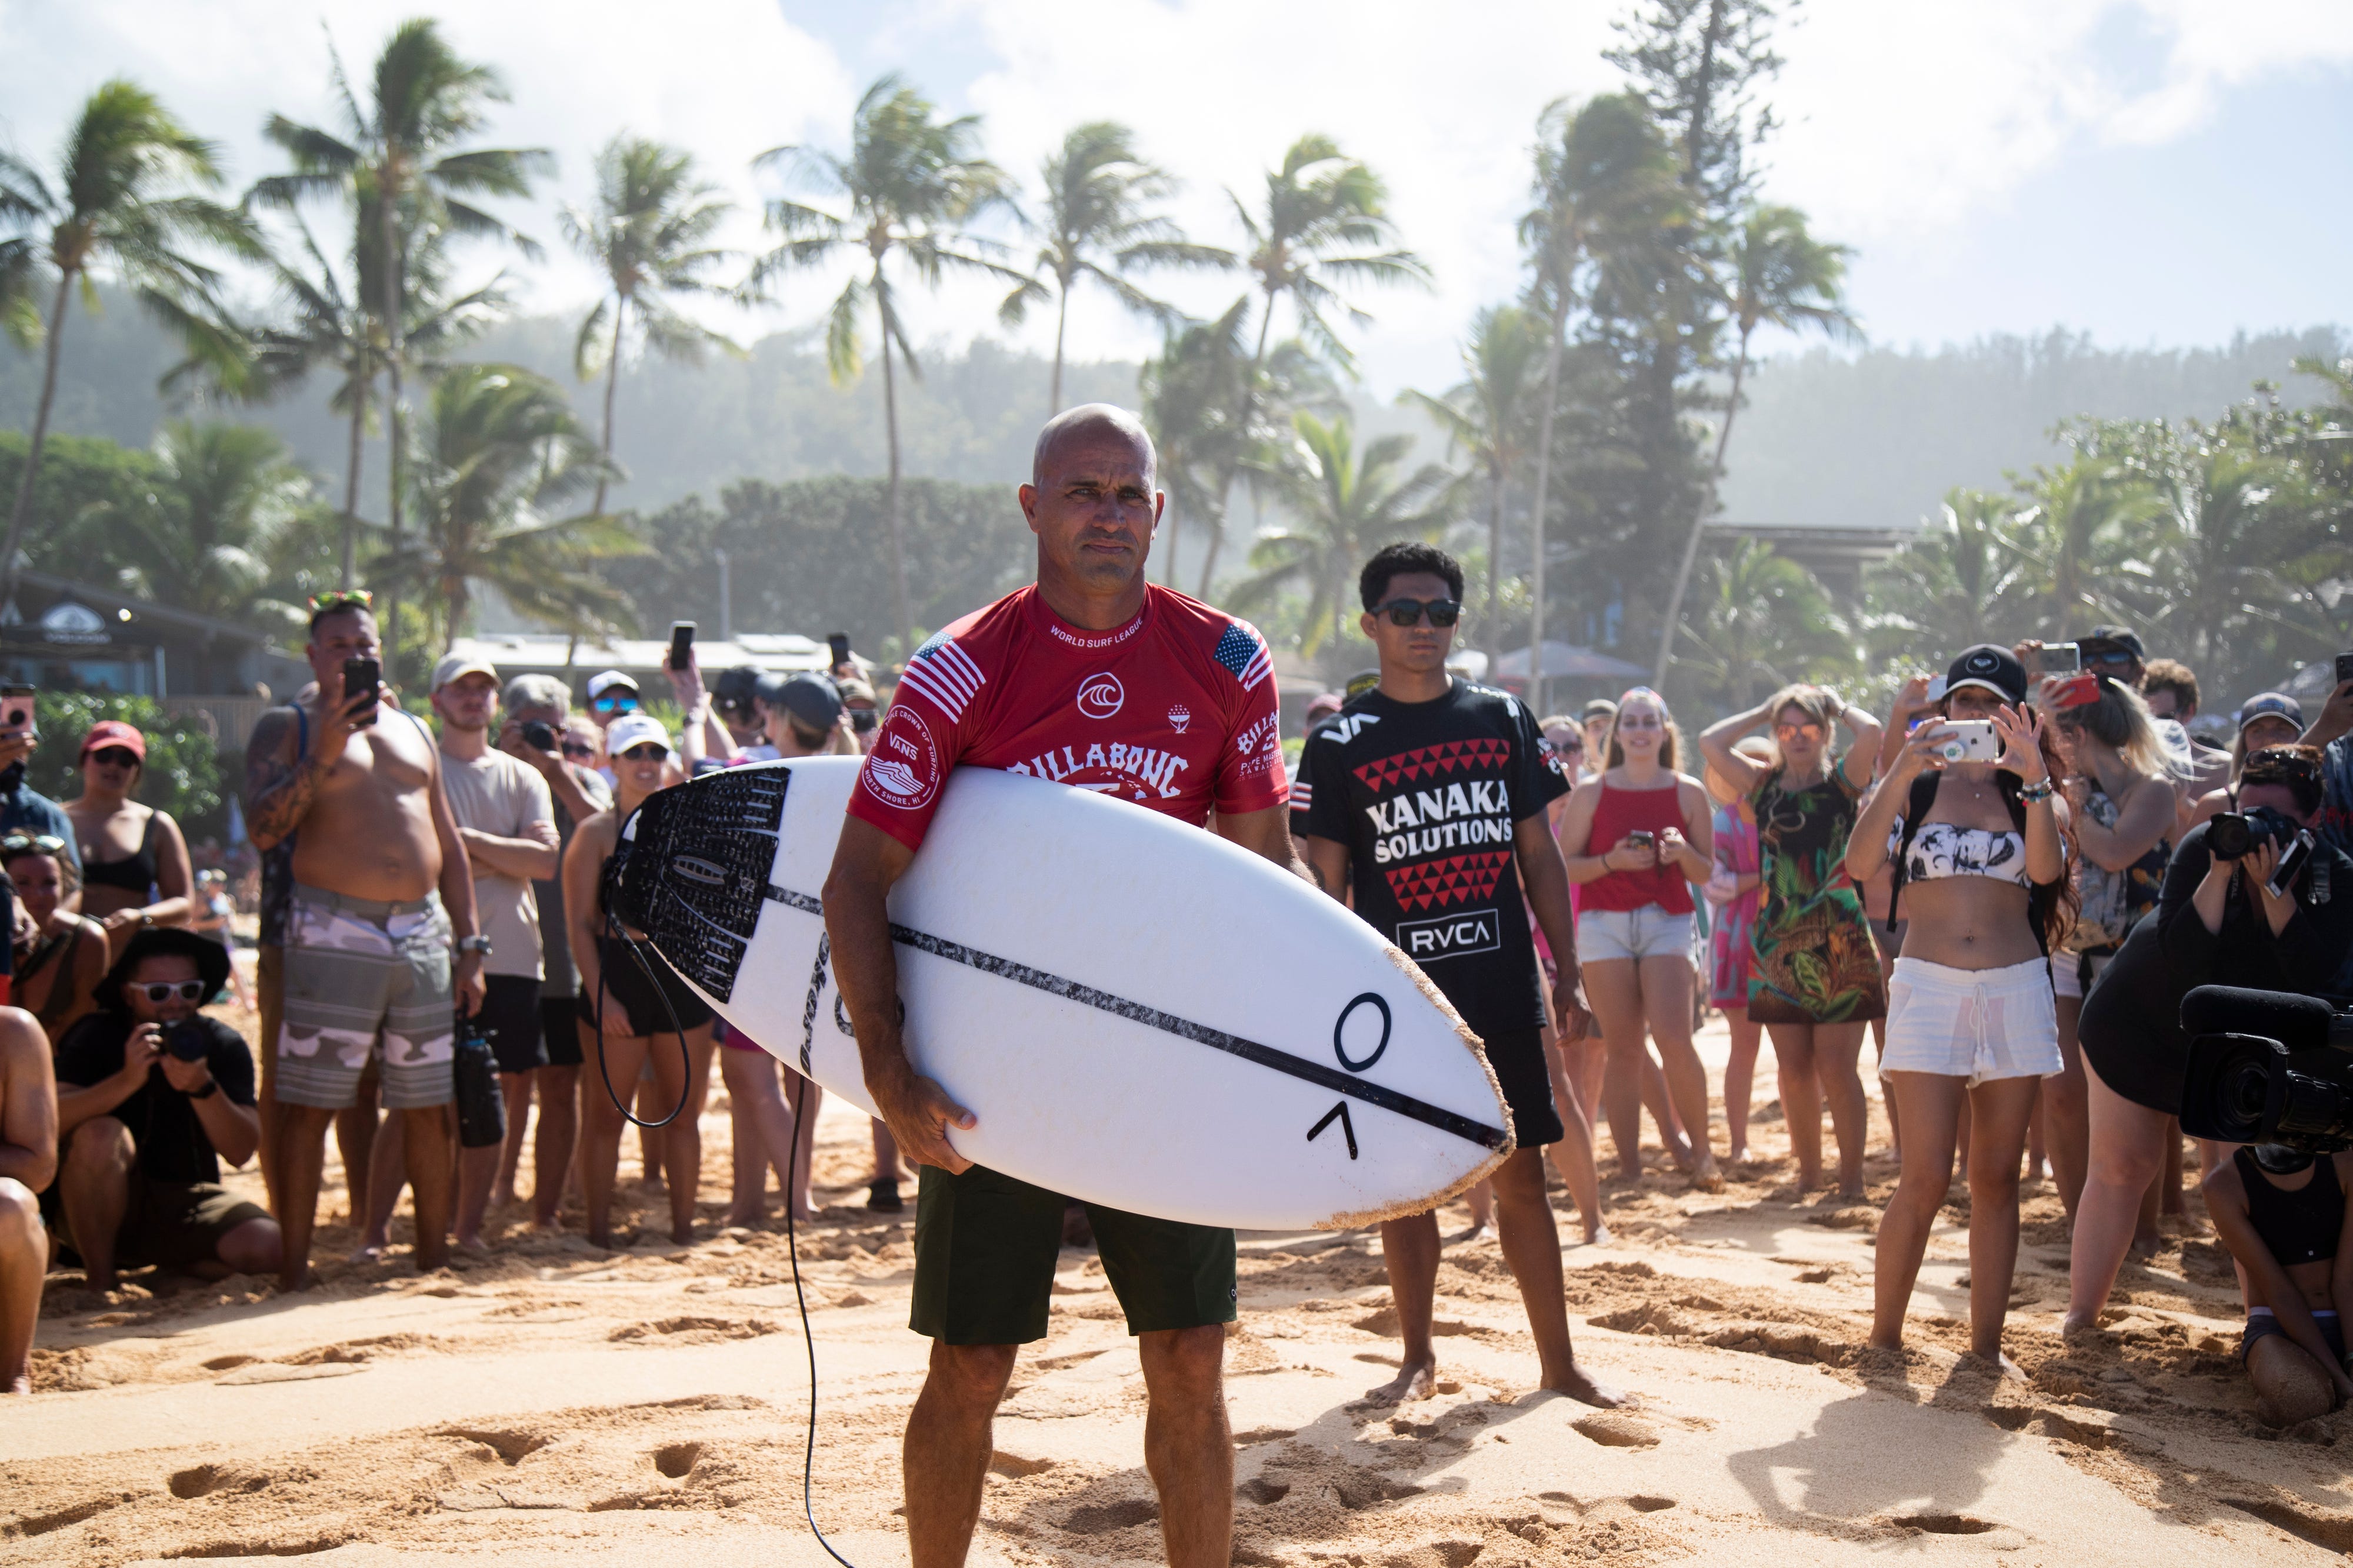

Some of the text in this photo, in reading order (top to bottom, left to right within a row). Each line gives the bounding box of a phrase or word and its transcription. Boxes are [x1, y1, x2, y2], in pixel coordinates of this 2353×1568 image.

[1050, 617, 1143, 648] WORLD SURF LEAGUE
[889, 731, 918, 761] VANS
[899, 710, 922, 731] CROWN
[921, 732, 930, 742] OF
[928, 746, 936, 783] SURFING
[1237, 709, 1280, 755] BILLA
[864, 769, 920, 806] NORTH SHORE, HI
[1366, 779, 1510, 836] KANAKA
[1374, 817, 1513, 863] SOLUTIONS
[1410, 920, 1490, 953] RVCA
